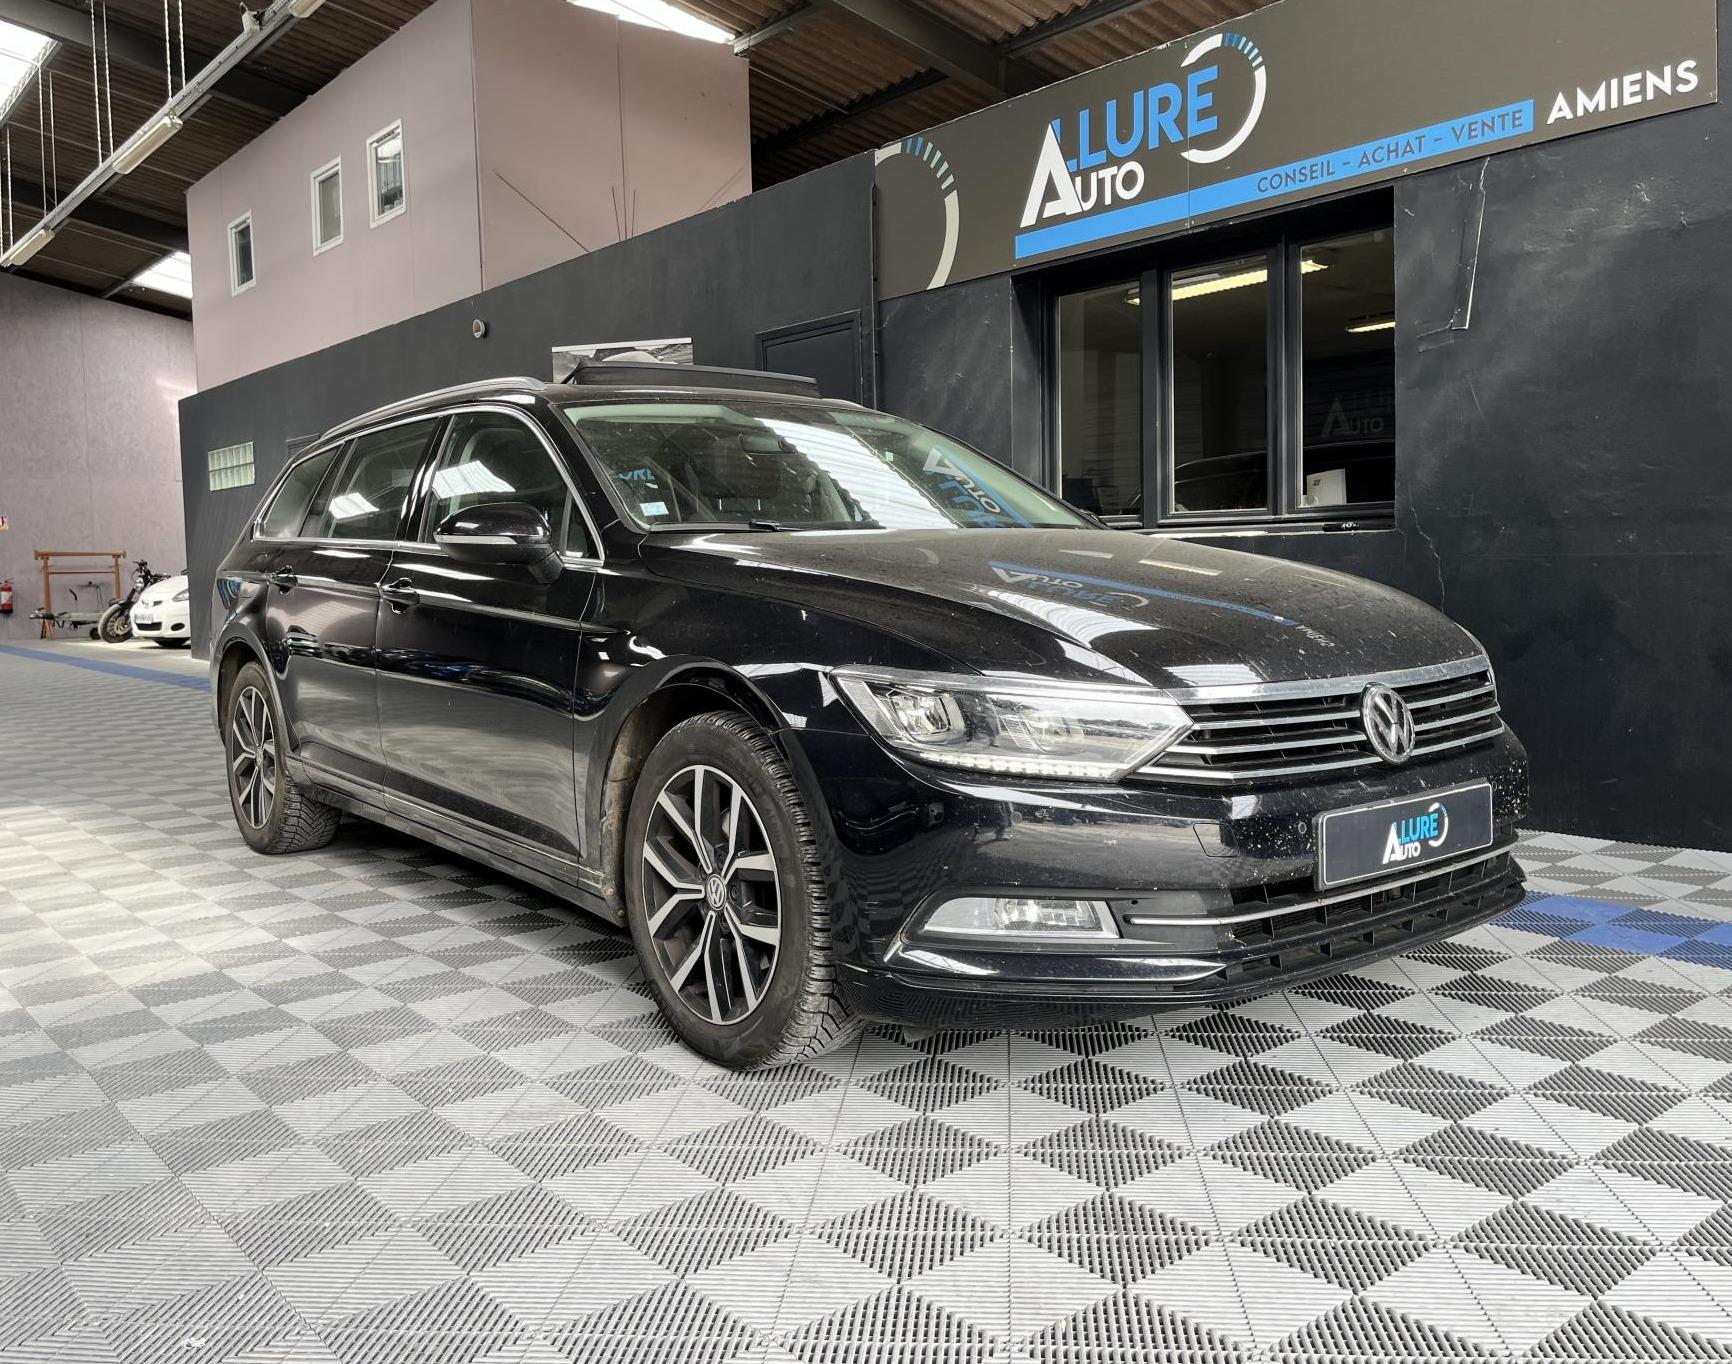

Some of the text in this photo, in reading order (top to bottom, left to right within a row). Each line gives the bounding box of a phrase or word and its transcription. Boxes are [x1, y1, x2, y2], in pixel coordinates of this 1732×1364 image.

[1546, 60, 1699, 125] AMIENS
[1020, 122, 1145, 228] AUTO
[1257, 160, 1335, 193] CONSEIL
[1358, 135, 1425, 168] ACHAT
[1452, 109, 1524, 143] VENTE
[1382, 822, 1421, 865] AUTO
